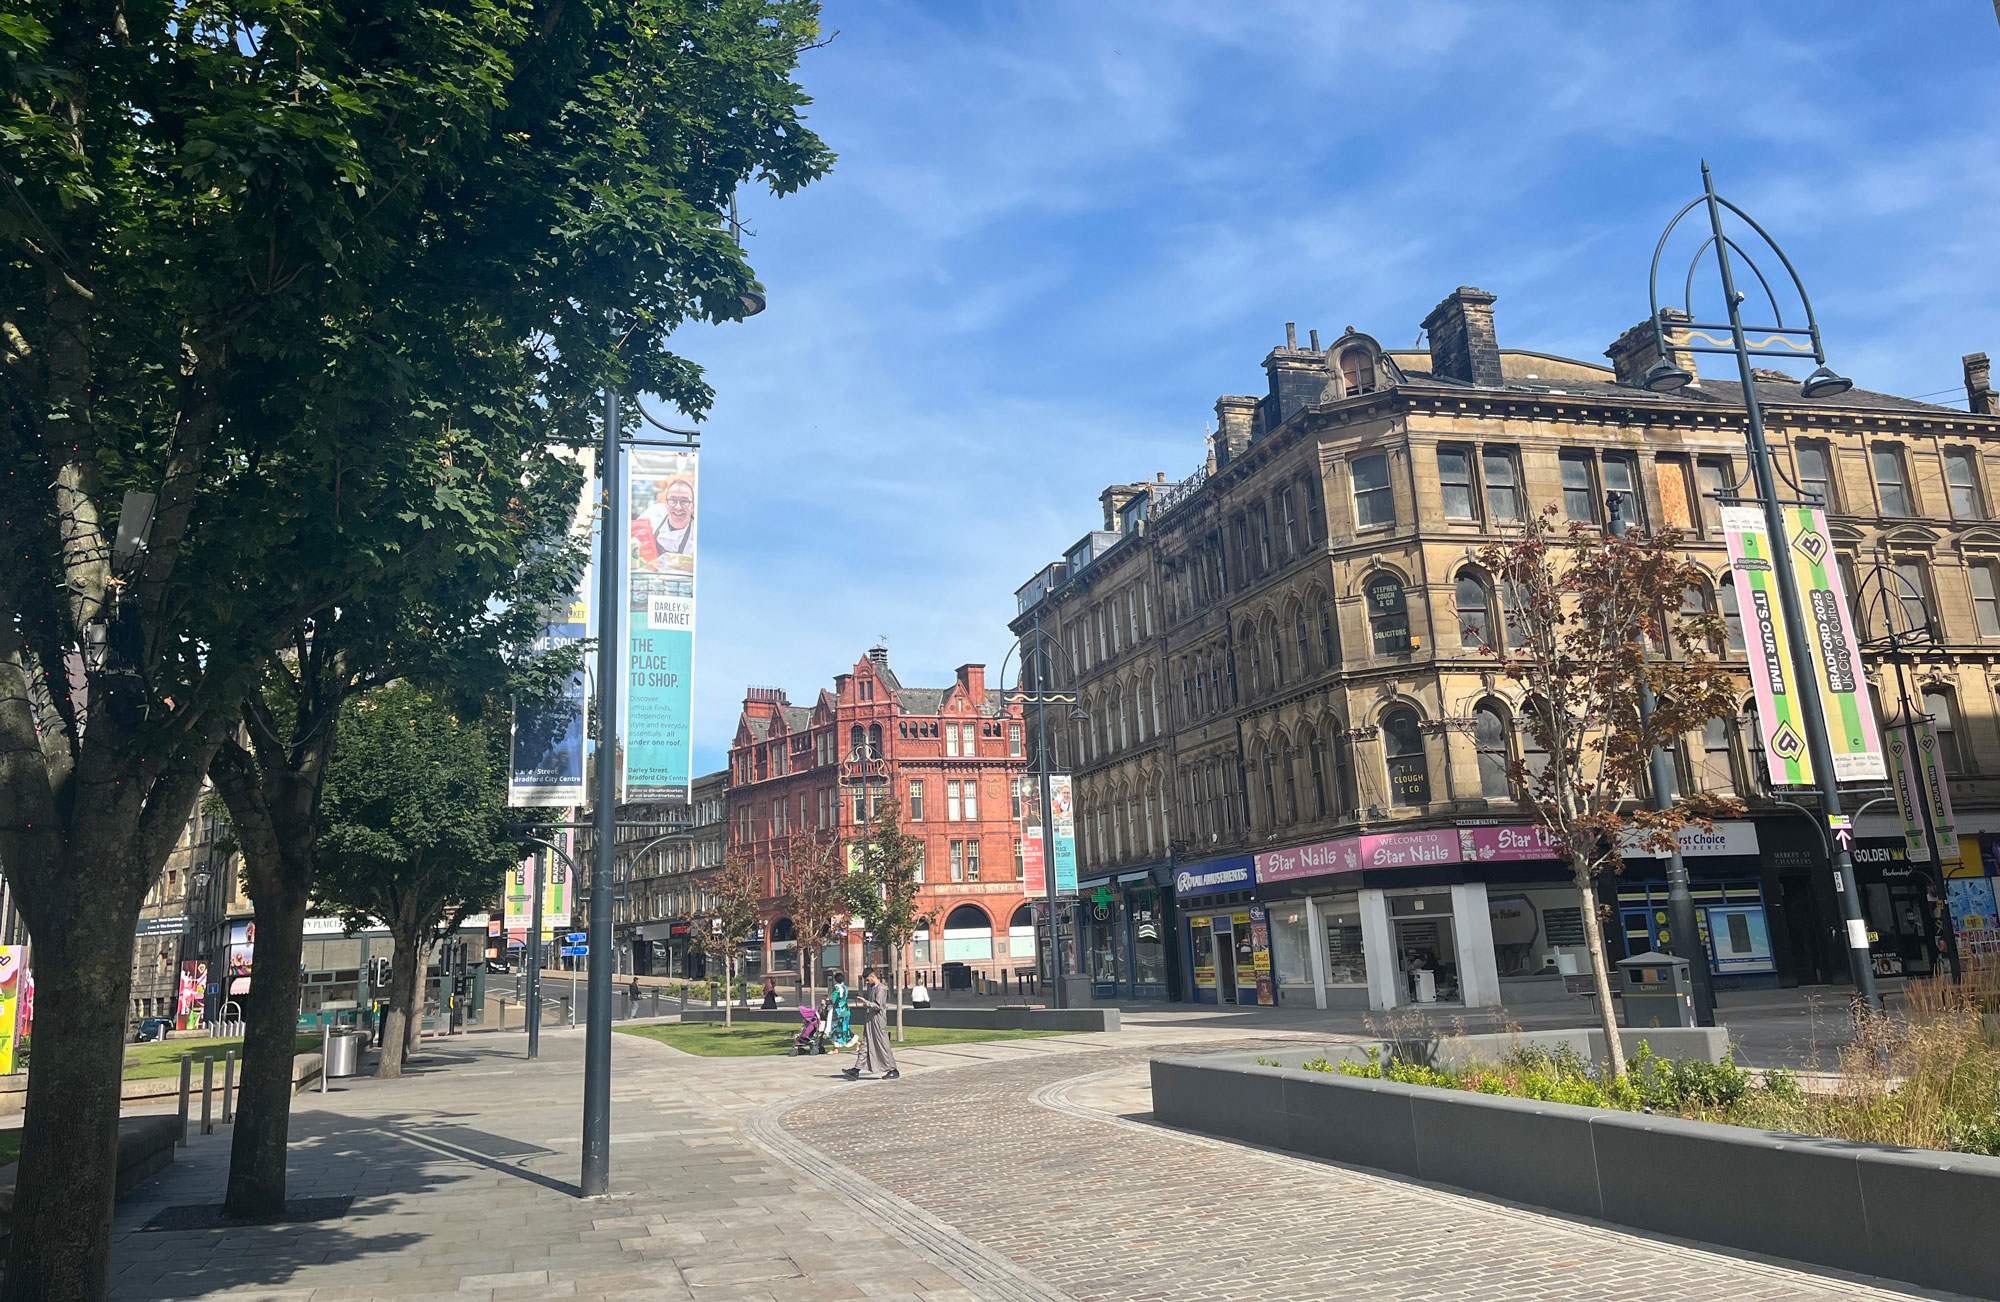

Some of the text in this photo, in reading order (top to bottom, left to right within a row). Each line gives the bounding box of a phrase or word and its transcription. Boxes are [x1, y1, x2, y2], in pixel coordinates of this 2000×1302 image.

[1372, 584, 1398, 594] STEPHEN
[654, 602, 680, 612] DARLEY
[654, 612, 690, 625] MARKET
[1374, 629, 1407, 640] SOLICITORS
[1812, 592, 1842, 690] BRADFORD 2025
[1825, 592, 1854, 690] UK City of Culture
[632, 638, 654, 652] THE
[1754, 593, 1783, 692] IT'S OUR TIME
[631, 655, 667, 670] PLACE
[631, 672, 679, 688] TO SHOP.
[1394, 774, 1424, 784] CLOUGH
[1899, 772, 1907, 790] TIME
[1929, 766, 1937, 786] TIME
[1379, 836, 1423, 846] WELCOME
[1498, 829, 1530, 848] Star
[1693, 834, 1725, 844] Choice
[1269, 847, 1336, 873] Star Nails
[1373, 844, 1448, 866] Star Nails
[1854, 848, 1890, 862] GOLDEN
[314, 920, 337, 928] PLAICE
